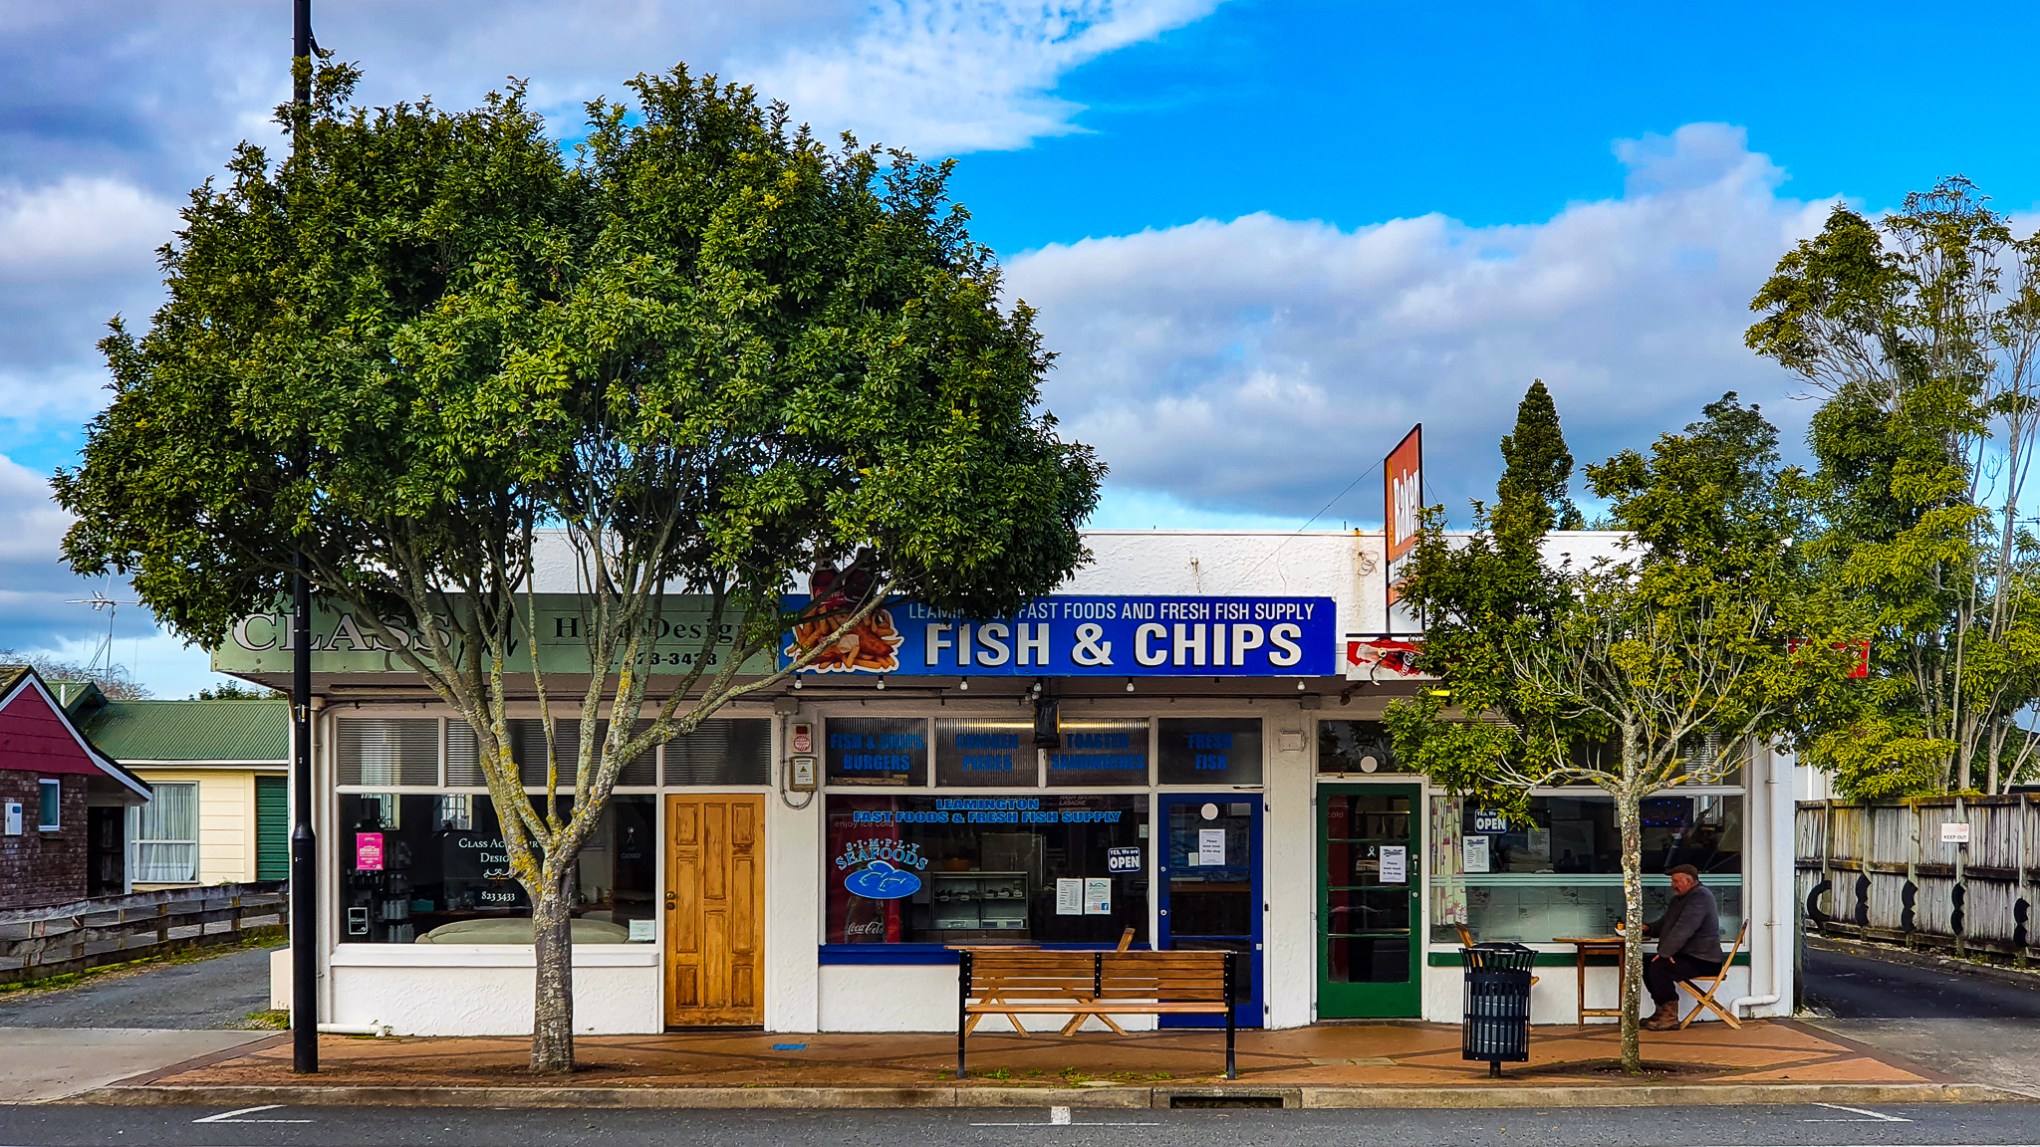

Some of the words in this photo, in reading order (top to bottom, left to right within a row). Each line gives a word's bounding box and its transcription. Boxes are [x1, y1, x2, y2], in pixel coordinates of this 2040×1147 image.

[1019, 602, 1059, 620] FAST
[1064, 602, 1117, 620] FOODS
[1121, 602, 1155, 620] AND
[1160, 602, 1210, 620] FRESH
[1215, 602, 1250, 620] FISH
[1254, 602, 1315, 620] SUPPLY
[925, 622, 1050, 667] FISH
[1071, 622, 1114, 667] &
[1134, 622, 1303, 667] CHIPS
[830, 733, 864, 749] FISH
[1188, 733, 1232, 749] FRESH
[843, 754, 911, 770] BURGERS
[1195, 754, 1227, 770] FISH
[936, 799, 1040, 810] LEAMINGTON
[853, 810, 892, 823] FAST
[896, 810, 948, 823] FOODS
[952, 811, 964, 823] &
[967, 810, 1018, 823] FRESH
[1021, 810, 1058, 823] FISH
[1062, 810, 1122, 823] SUPPLY
[1476, 818, 1506, 830] OPEN
[835, 846, 929, 871] SEAFOODS
[1110, 856, 1140, 869] OPEN
[481, 890, 495, 902] 823
[496, 890, 516, 902] 3433
